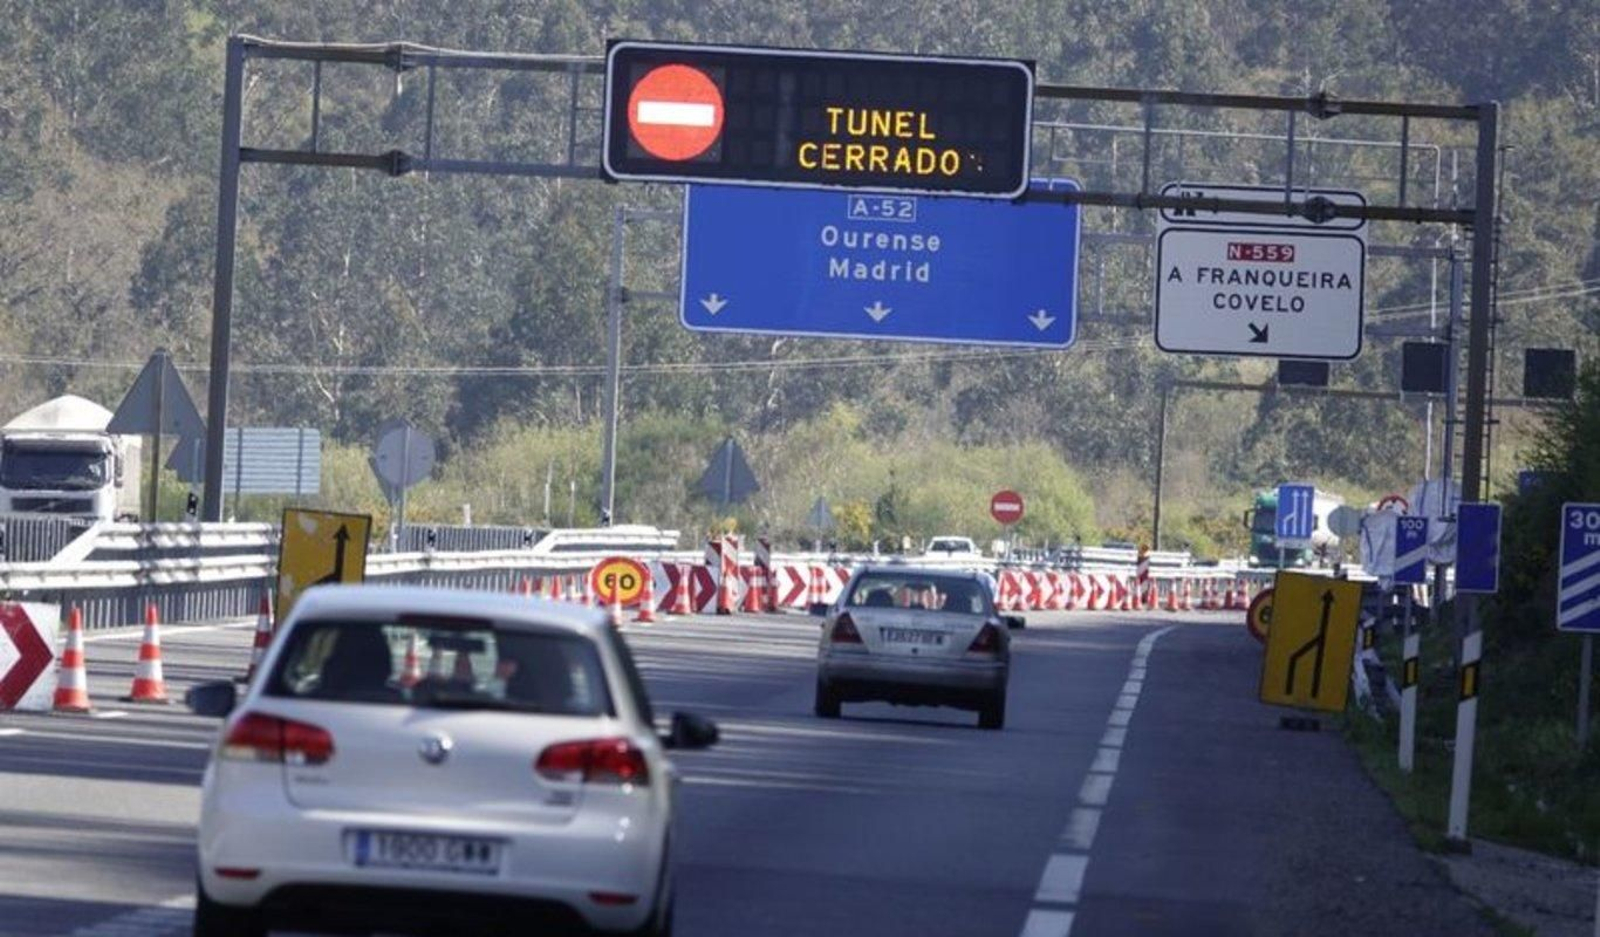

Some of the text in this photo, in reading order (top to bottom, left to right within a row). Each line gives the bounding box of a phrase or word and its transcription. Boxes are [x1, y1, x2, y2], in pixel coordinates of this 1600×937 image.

[827, 106, 936, 139] TUNEL
[798, 143, 961, 176] CERRADO
[852, 200, 914, 219] A-52
[820, 225, 941, 253] Ourense
[1229, 244, 1294, 262] N-559
[828, 258, 931, 284] Madrid
[1167, 266, 1353, 290] A FRANQUEIRA
[1212, 293, 1305, 313] COVELO
[1400, 518, 1425, 531] 100
[604, 572, 636, 591] 60
